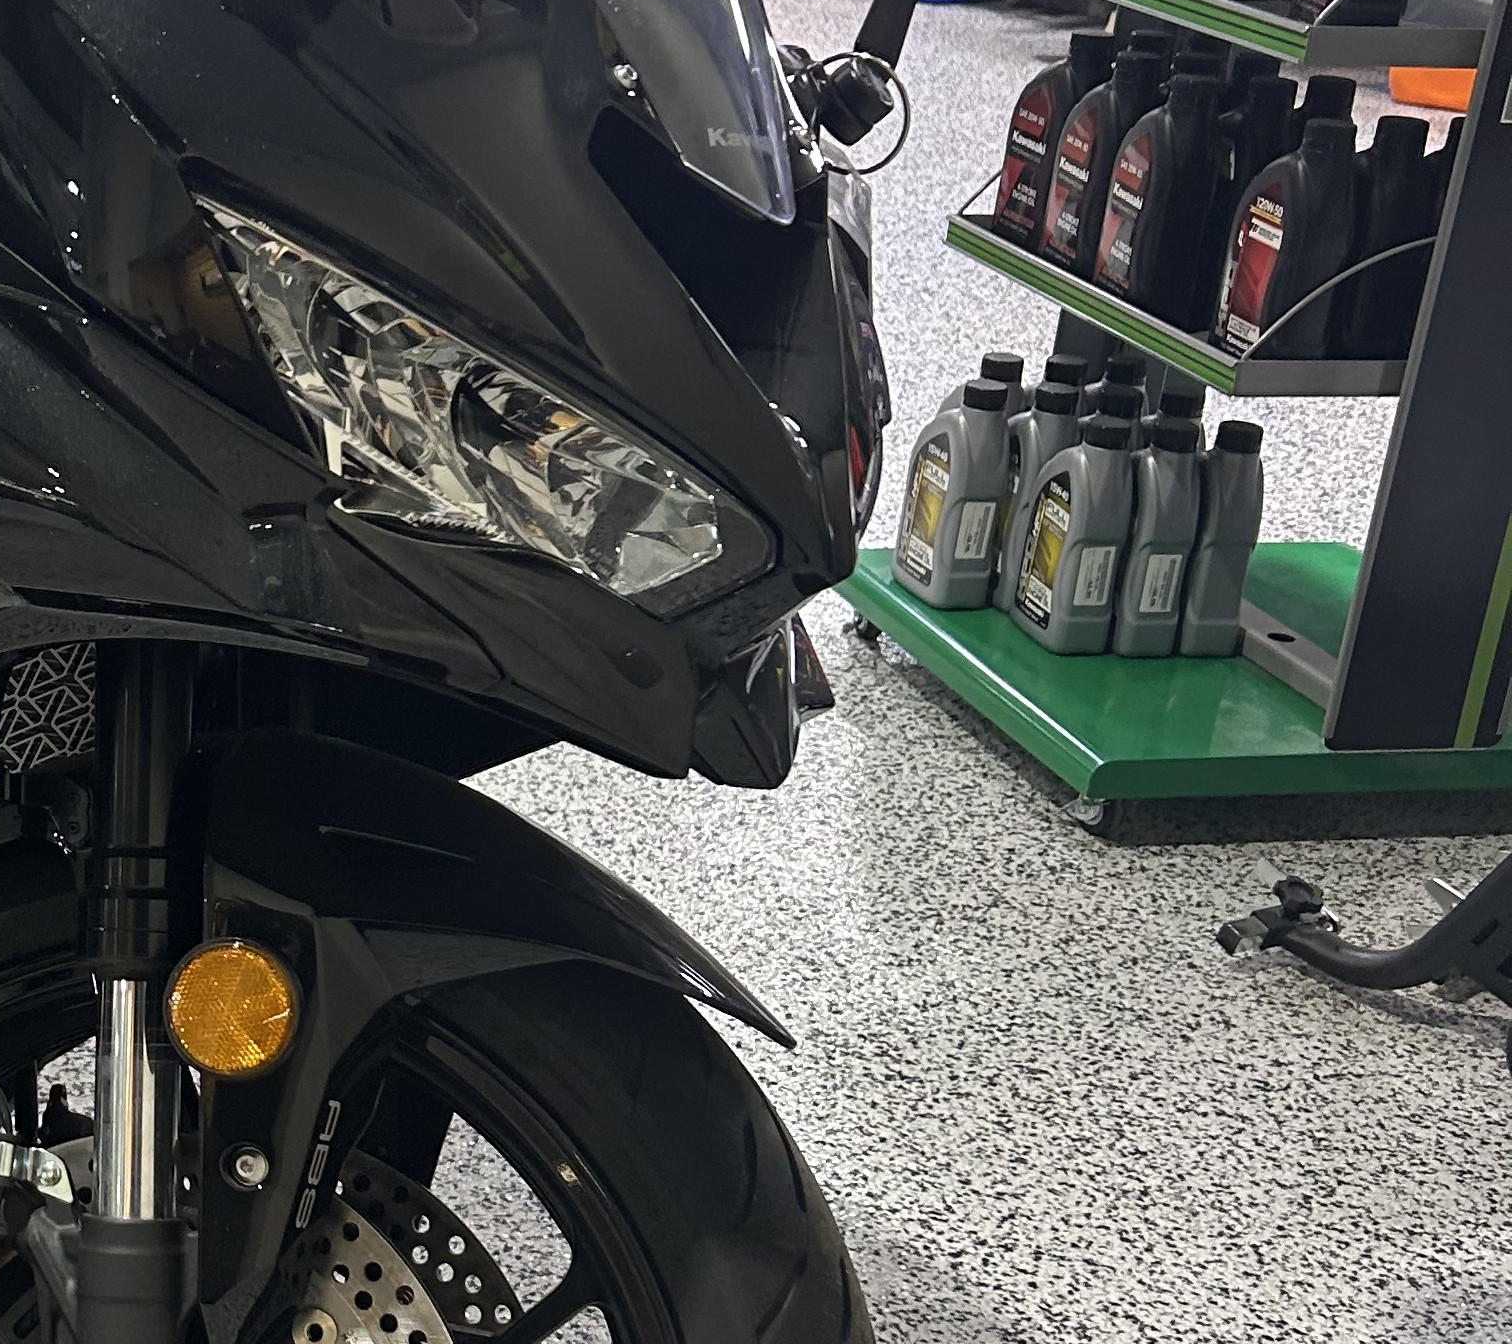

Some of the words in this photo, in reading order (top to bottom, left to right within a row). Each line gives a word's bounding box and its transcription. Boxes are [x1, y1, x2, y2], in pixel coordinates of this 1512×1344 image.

[1012, 130, 1047, 156] Kawasaki
[1059, 156, 1090, 183] Kawasaki
[1113, 182, 1144, 211] Kawasaki
[296, 1100, 341, 1229] ABS
